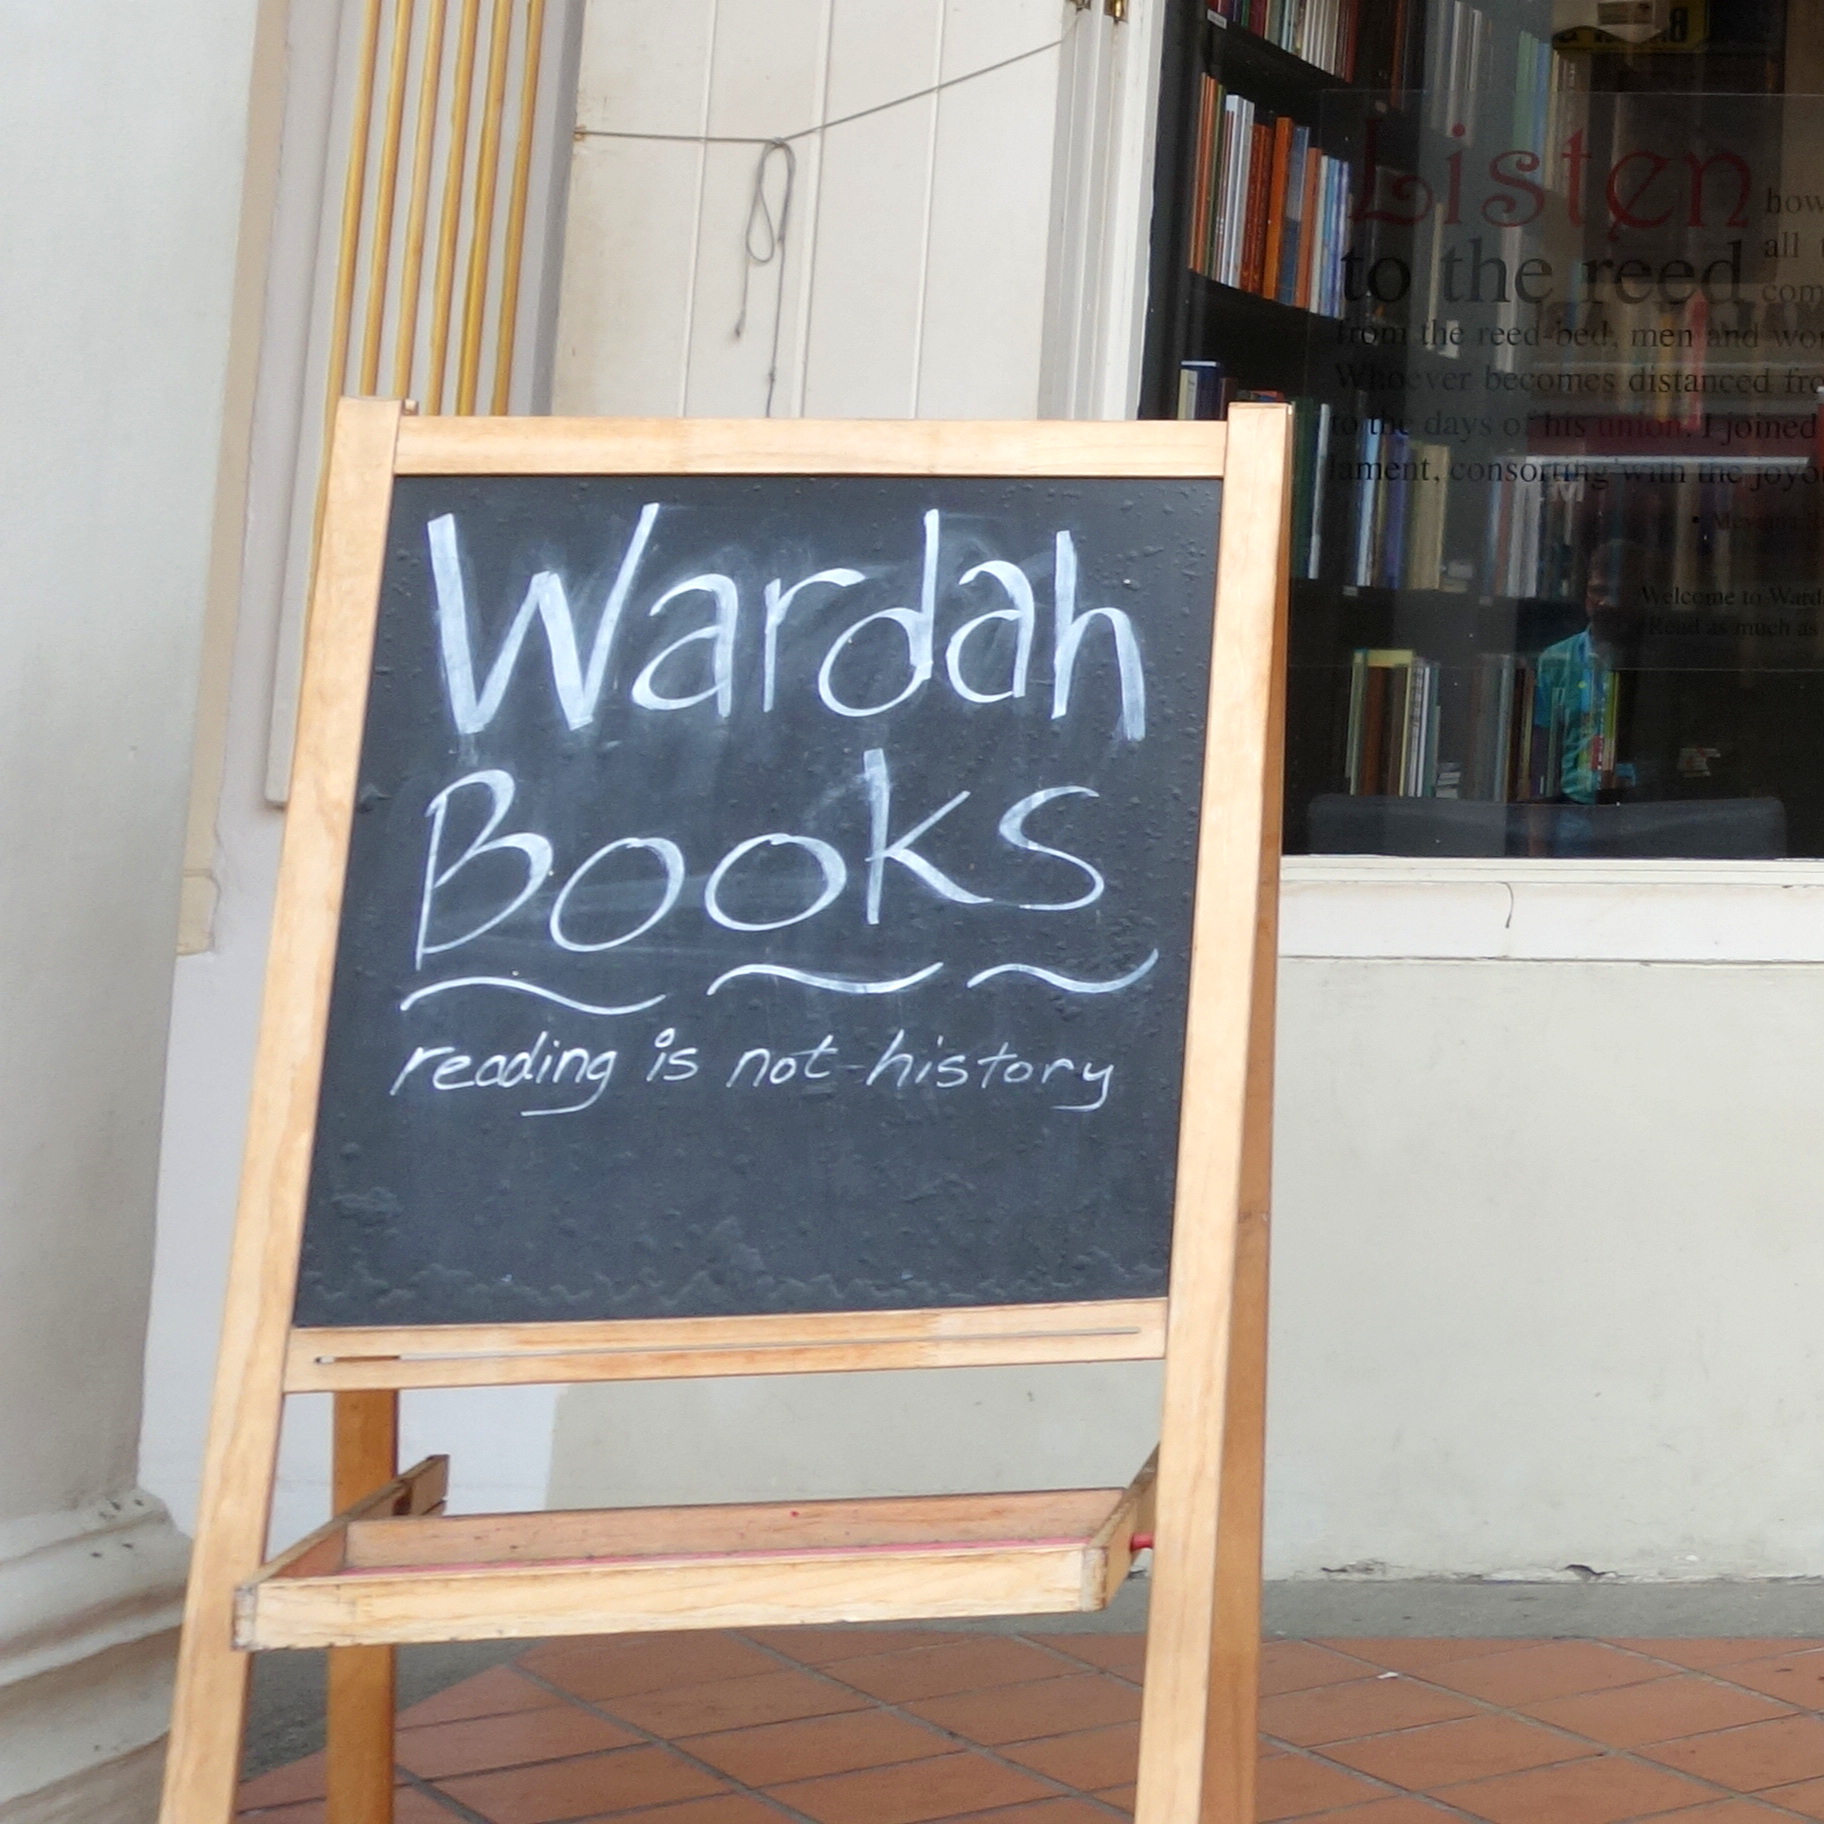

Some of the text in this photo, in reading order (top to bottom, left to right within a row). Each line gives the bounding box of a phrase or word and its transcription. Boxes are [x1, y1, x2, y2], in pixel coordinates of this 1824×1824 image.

[1349, 119, 1753, 241] Listen
[1764, 232, 1799, 259] all
[1342, 238, 1744, 304] to the reed
[1336, 319, 1406, 346] from
[1420, 319, 1464, 346] the
[1632, 327, 1694, 347] men
[1706, 321, 1758, 349] and
[1484, 366, 1614, 392] becomes
[1629, 366, 1770, 393] distanced
[1331, 414, 1358, 437] to
[1424, 411, 1493, 443] days
[1543, 413, 1587, 438] his
[1719, 412, 1817, 447] joined
[1328, 457, 1440, 484] lament,
[1641, 584, 1735, 607] Welcome
[1743, 587, 1763, 607] to
[427, 503, 1145, 742] Wardah
[1735, 618, 1790, 636] much
[416, 748, 1105, 971] Books
[391, 1027, 1114, 1115] reading is not history
